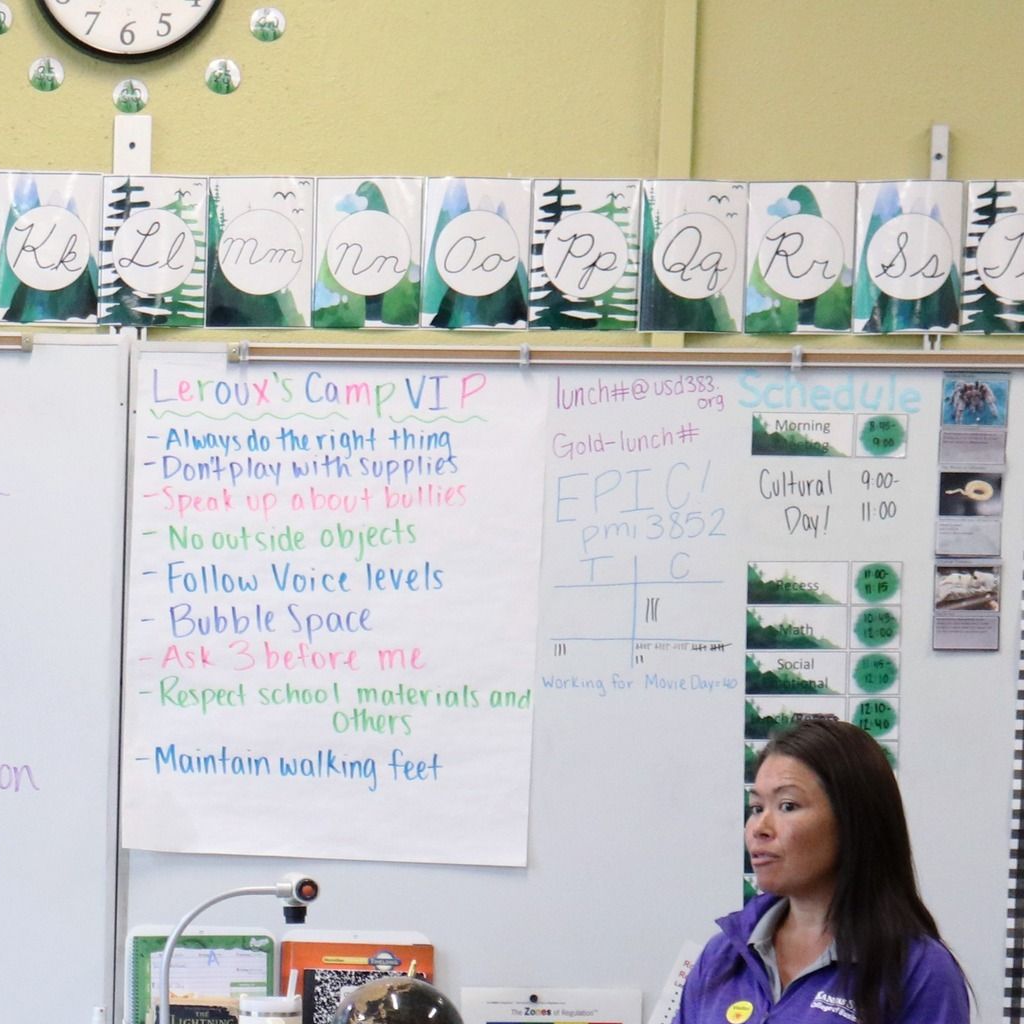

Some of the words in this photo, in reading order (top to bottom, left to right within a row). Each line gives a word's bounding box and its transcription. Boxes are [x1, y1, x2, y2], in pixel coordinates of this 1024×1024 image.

[84, 11, 100, 35] 7
[119, 21, 135, 46] 6
[156, 12, 172, 37] 5
[16, 221, 83, 273] Kk
[119, 221, 184, 270] Ll
[221, 236, 303, 265] Mm
[335, 240, 407, 276] Nn
[444, 235, 516, 273] Oo
[552, 233, 618, 288] Pp
[662, 225, 726, 282] Qq
[763, 231, 836, 280] Rr
[876, 231, 945, 280] Ss
[152, 369, 294, 406] Leroux's
[305, 371, 395, 418] Camp
[697, 394, 725, 412] org
[737, 369, 923, 414] Schedule
[776, 419, 831, 433] Morning
[166, 429, 241, 456] Always
[247, 429, 271, 452] do
[277, 428, 311, 452] the
[316, 428, 377, 459] right
[388, 429, 452, 459] thing
[230, 457, 282, 487] play
[292, 455, 352, 478] with
[360, 455, 459, 487] supplies
[759, 468, 833, 499] Cultural
[162, 486, 232, 521] Speak
[247, 493, 278, 519] up
[292, 487, 374, 512] about
[386, 484, 467, 510] bullies
[784, 505, 831, 538] Day!
[168, 525, 204, 551] No
[212, 525, 306, 552] outside
[320, 519, 418, 563] objects
[167, 561, 258, 593] Follow
[271, 562, 351, 593] Voice
[366, 562, 444, 593] levels
[579, 556, 614, 582] T
[670, 552, 691, 579] C
[777, 580, 819, 591] Recess
[169, 603, 276, 639] Bubble
[288, 604, 374, 644] Space
[779, 624, 814, 636] Math
[161, 645, 217, 670] Ask
[229, 640, 256, 671] 3
[264, 641, 362, 672] before
[378, 647, 427, 670] me
[777, 658, 815, 670] Social
[159, 675, 247, 715] Respect
[257, 682, 341, 705] school
[356, 683, 480, 709] materials
[489, 689, 532, 709] and
[542, 674, 606, 697] Working
[612, 674, 634, 690] for
[645, 674, 687, 690] Movie
[154, 744, 271, 777] Maintain
[279, 749, 377, 792] walking
[387, 748, 444, 782] feet
[524, 1007, 552, 1016] Zones
